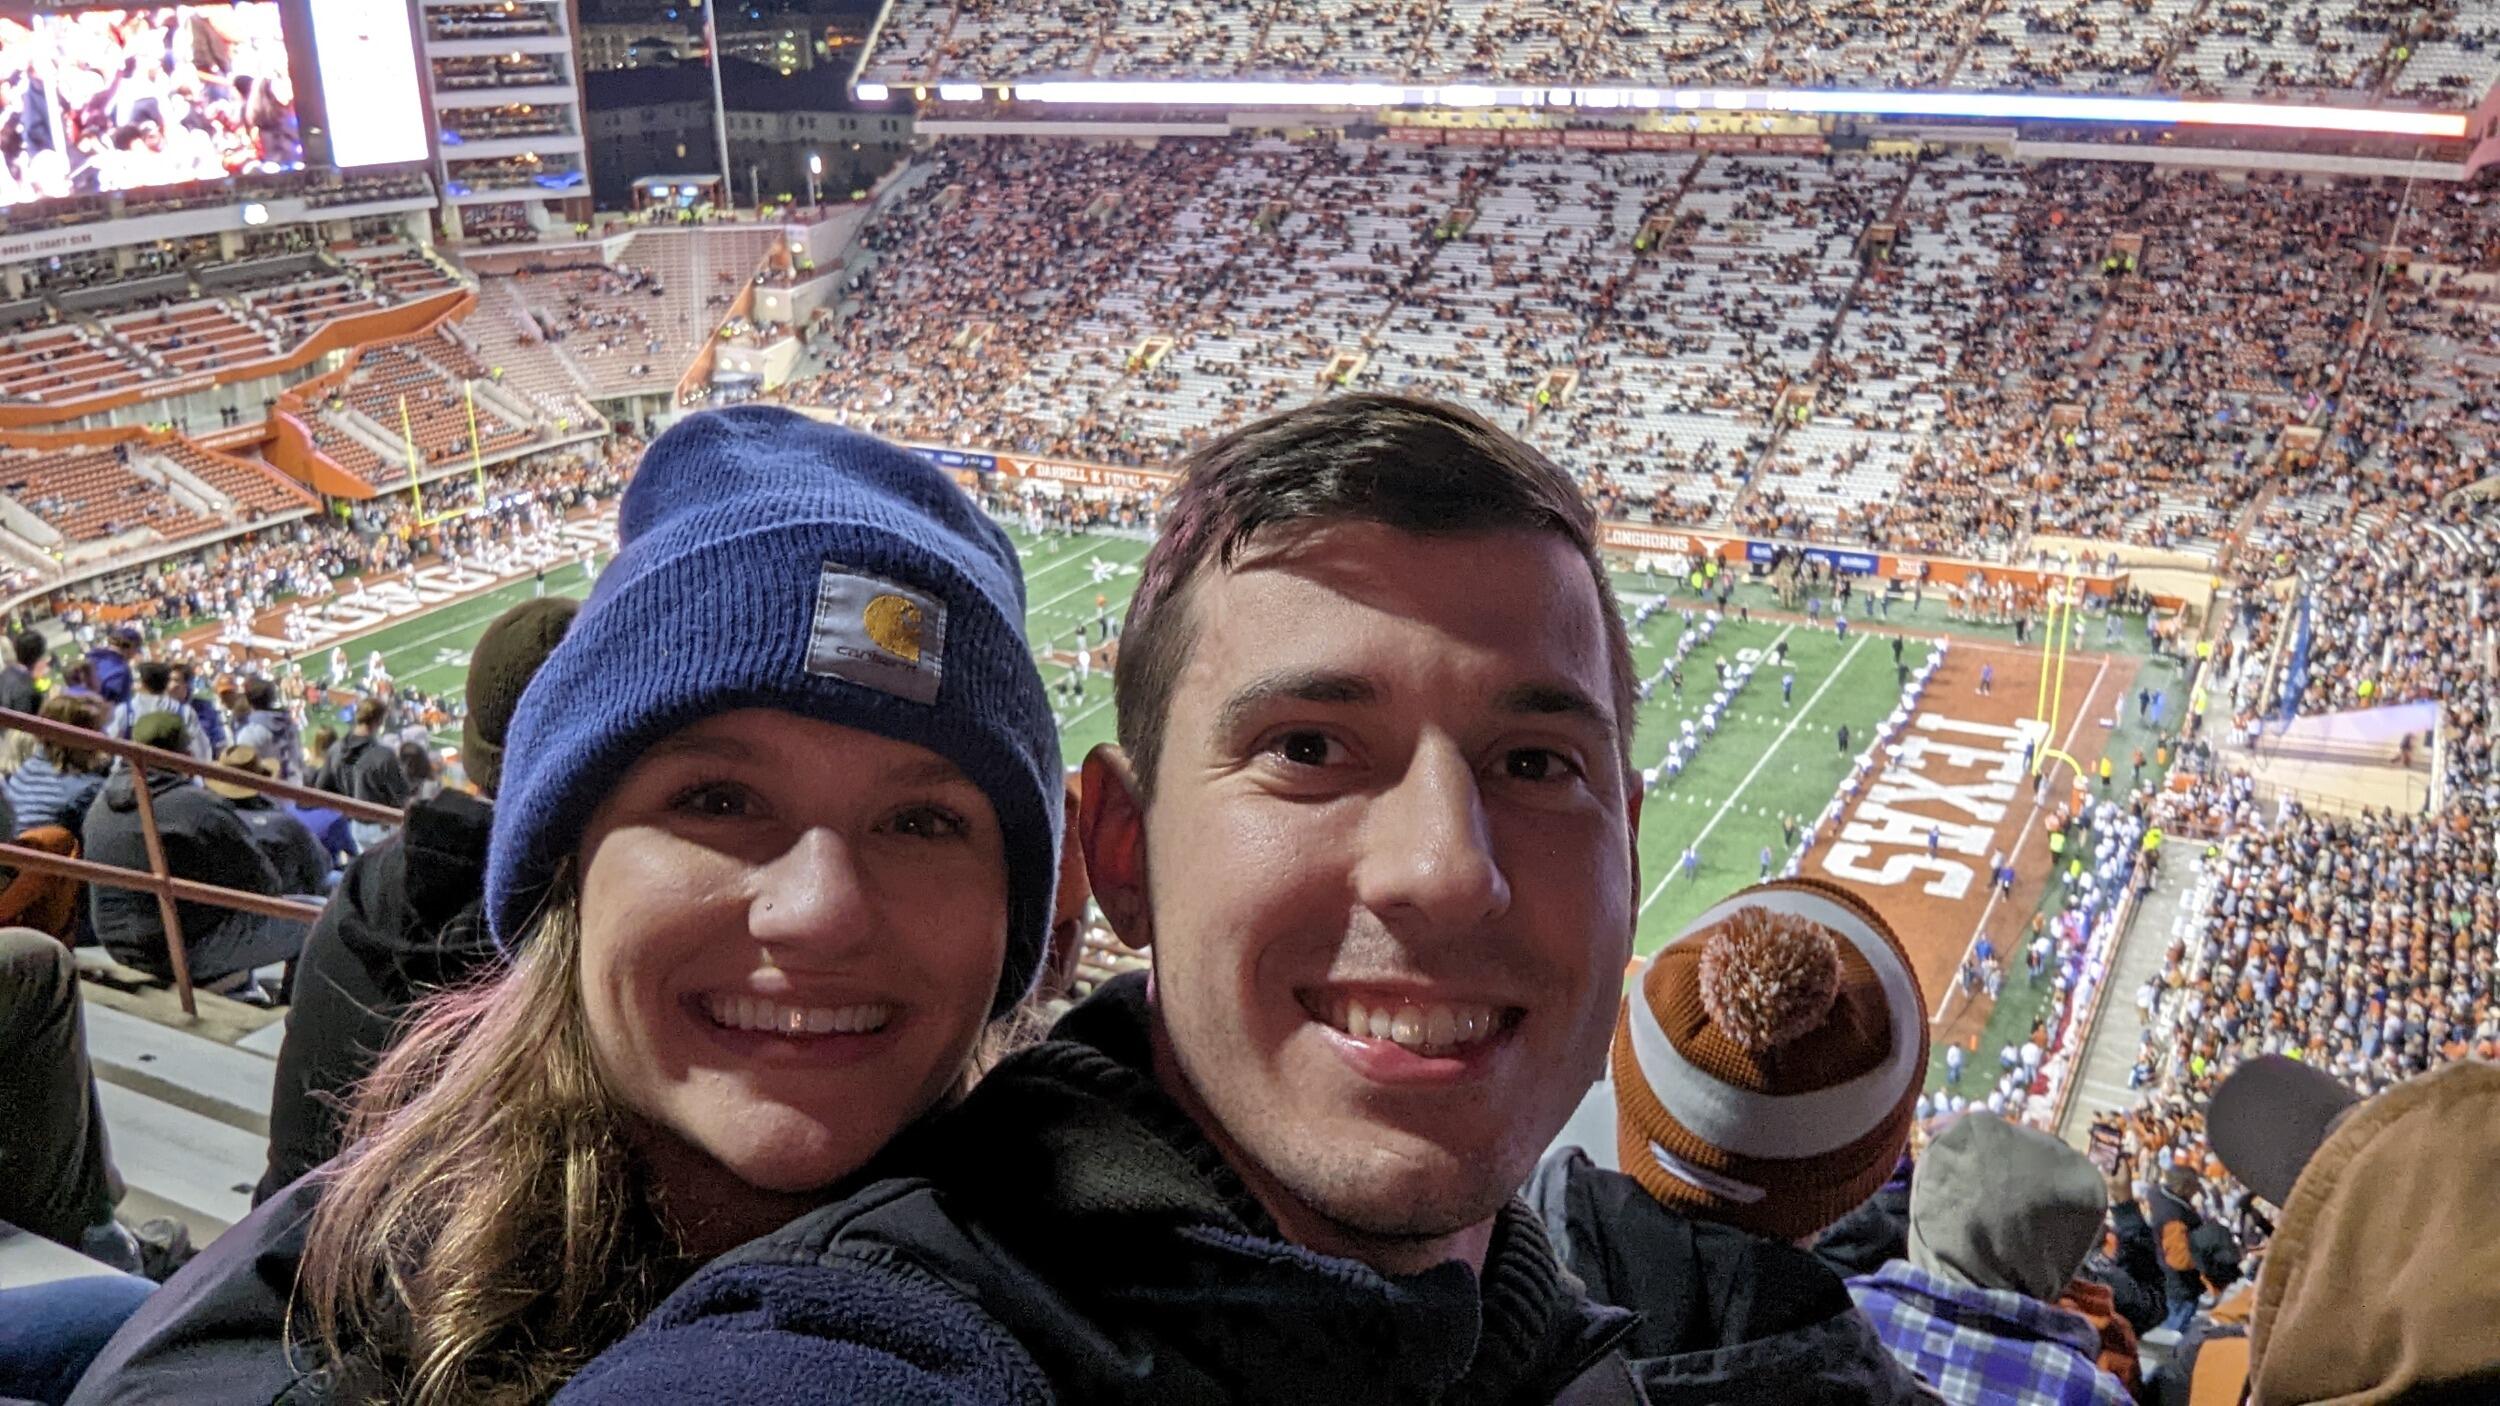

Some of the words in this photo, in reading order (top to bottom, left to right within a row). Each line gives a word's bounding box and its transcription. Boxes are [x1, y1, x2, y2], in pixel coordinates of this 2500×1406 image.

[1035, 463, 1088, 483] DARRELL
[1604, 528, 1690, 553] LONGHORNS
[1821, 712, 2050, 900] TEXAS
